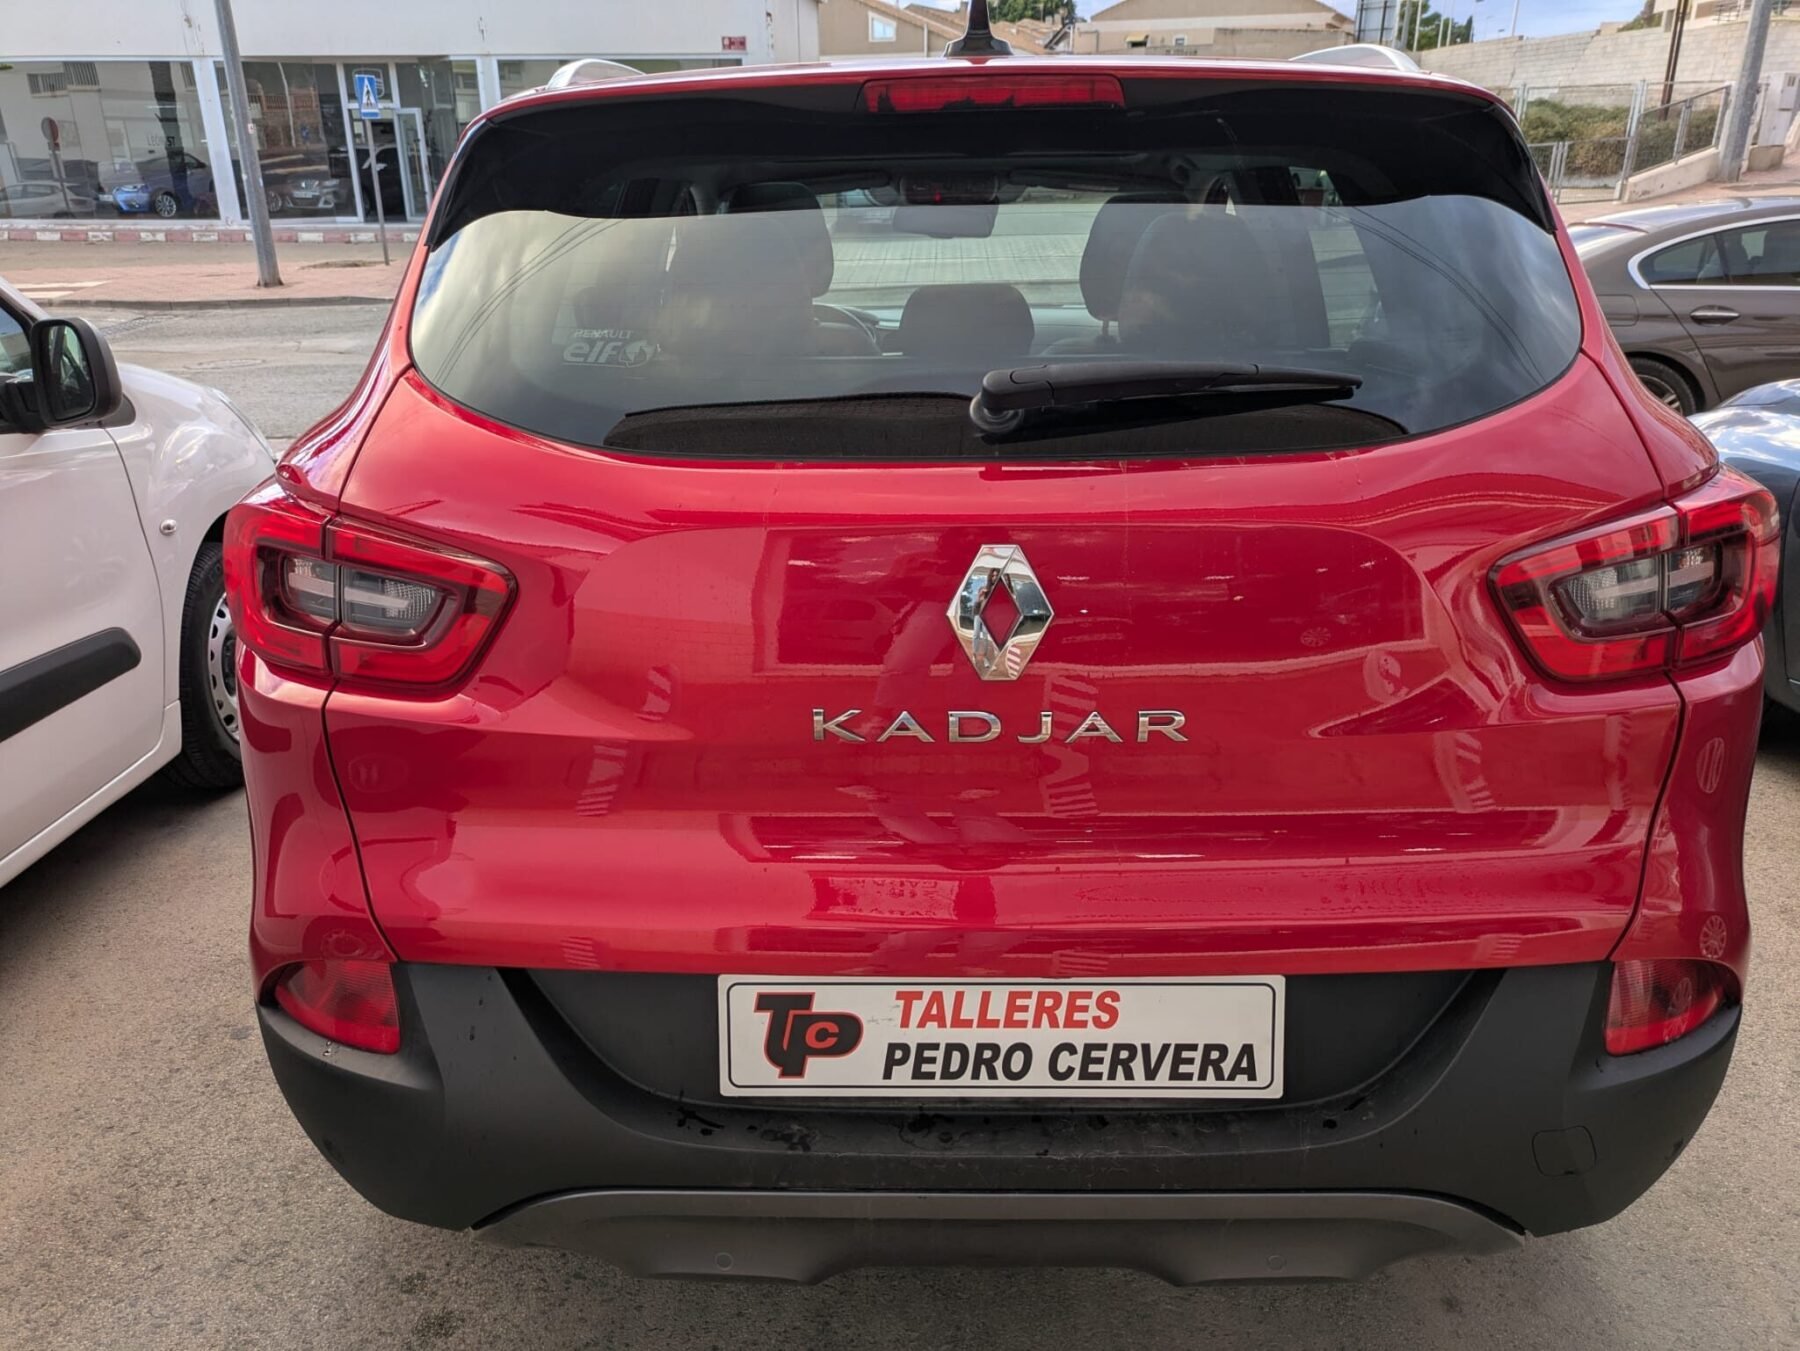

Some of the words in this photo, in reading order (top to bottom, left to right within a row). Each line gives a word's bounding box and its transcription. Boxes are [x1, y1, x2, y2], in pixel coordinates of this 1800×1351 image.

[574, 328, 633, 339] RENAULT
[563, 341, 623, 363] elf
[812, 708, 1189, 743] KADJAR
[895, 990, 1121, 1030] TALLERES
[882, 1041, 1033, 1081] PEDRO
[1047, 1042, 1258, 1082] CERVERA
